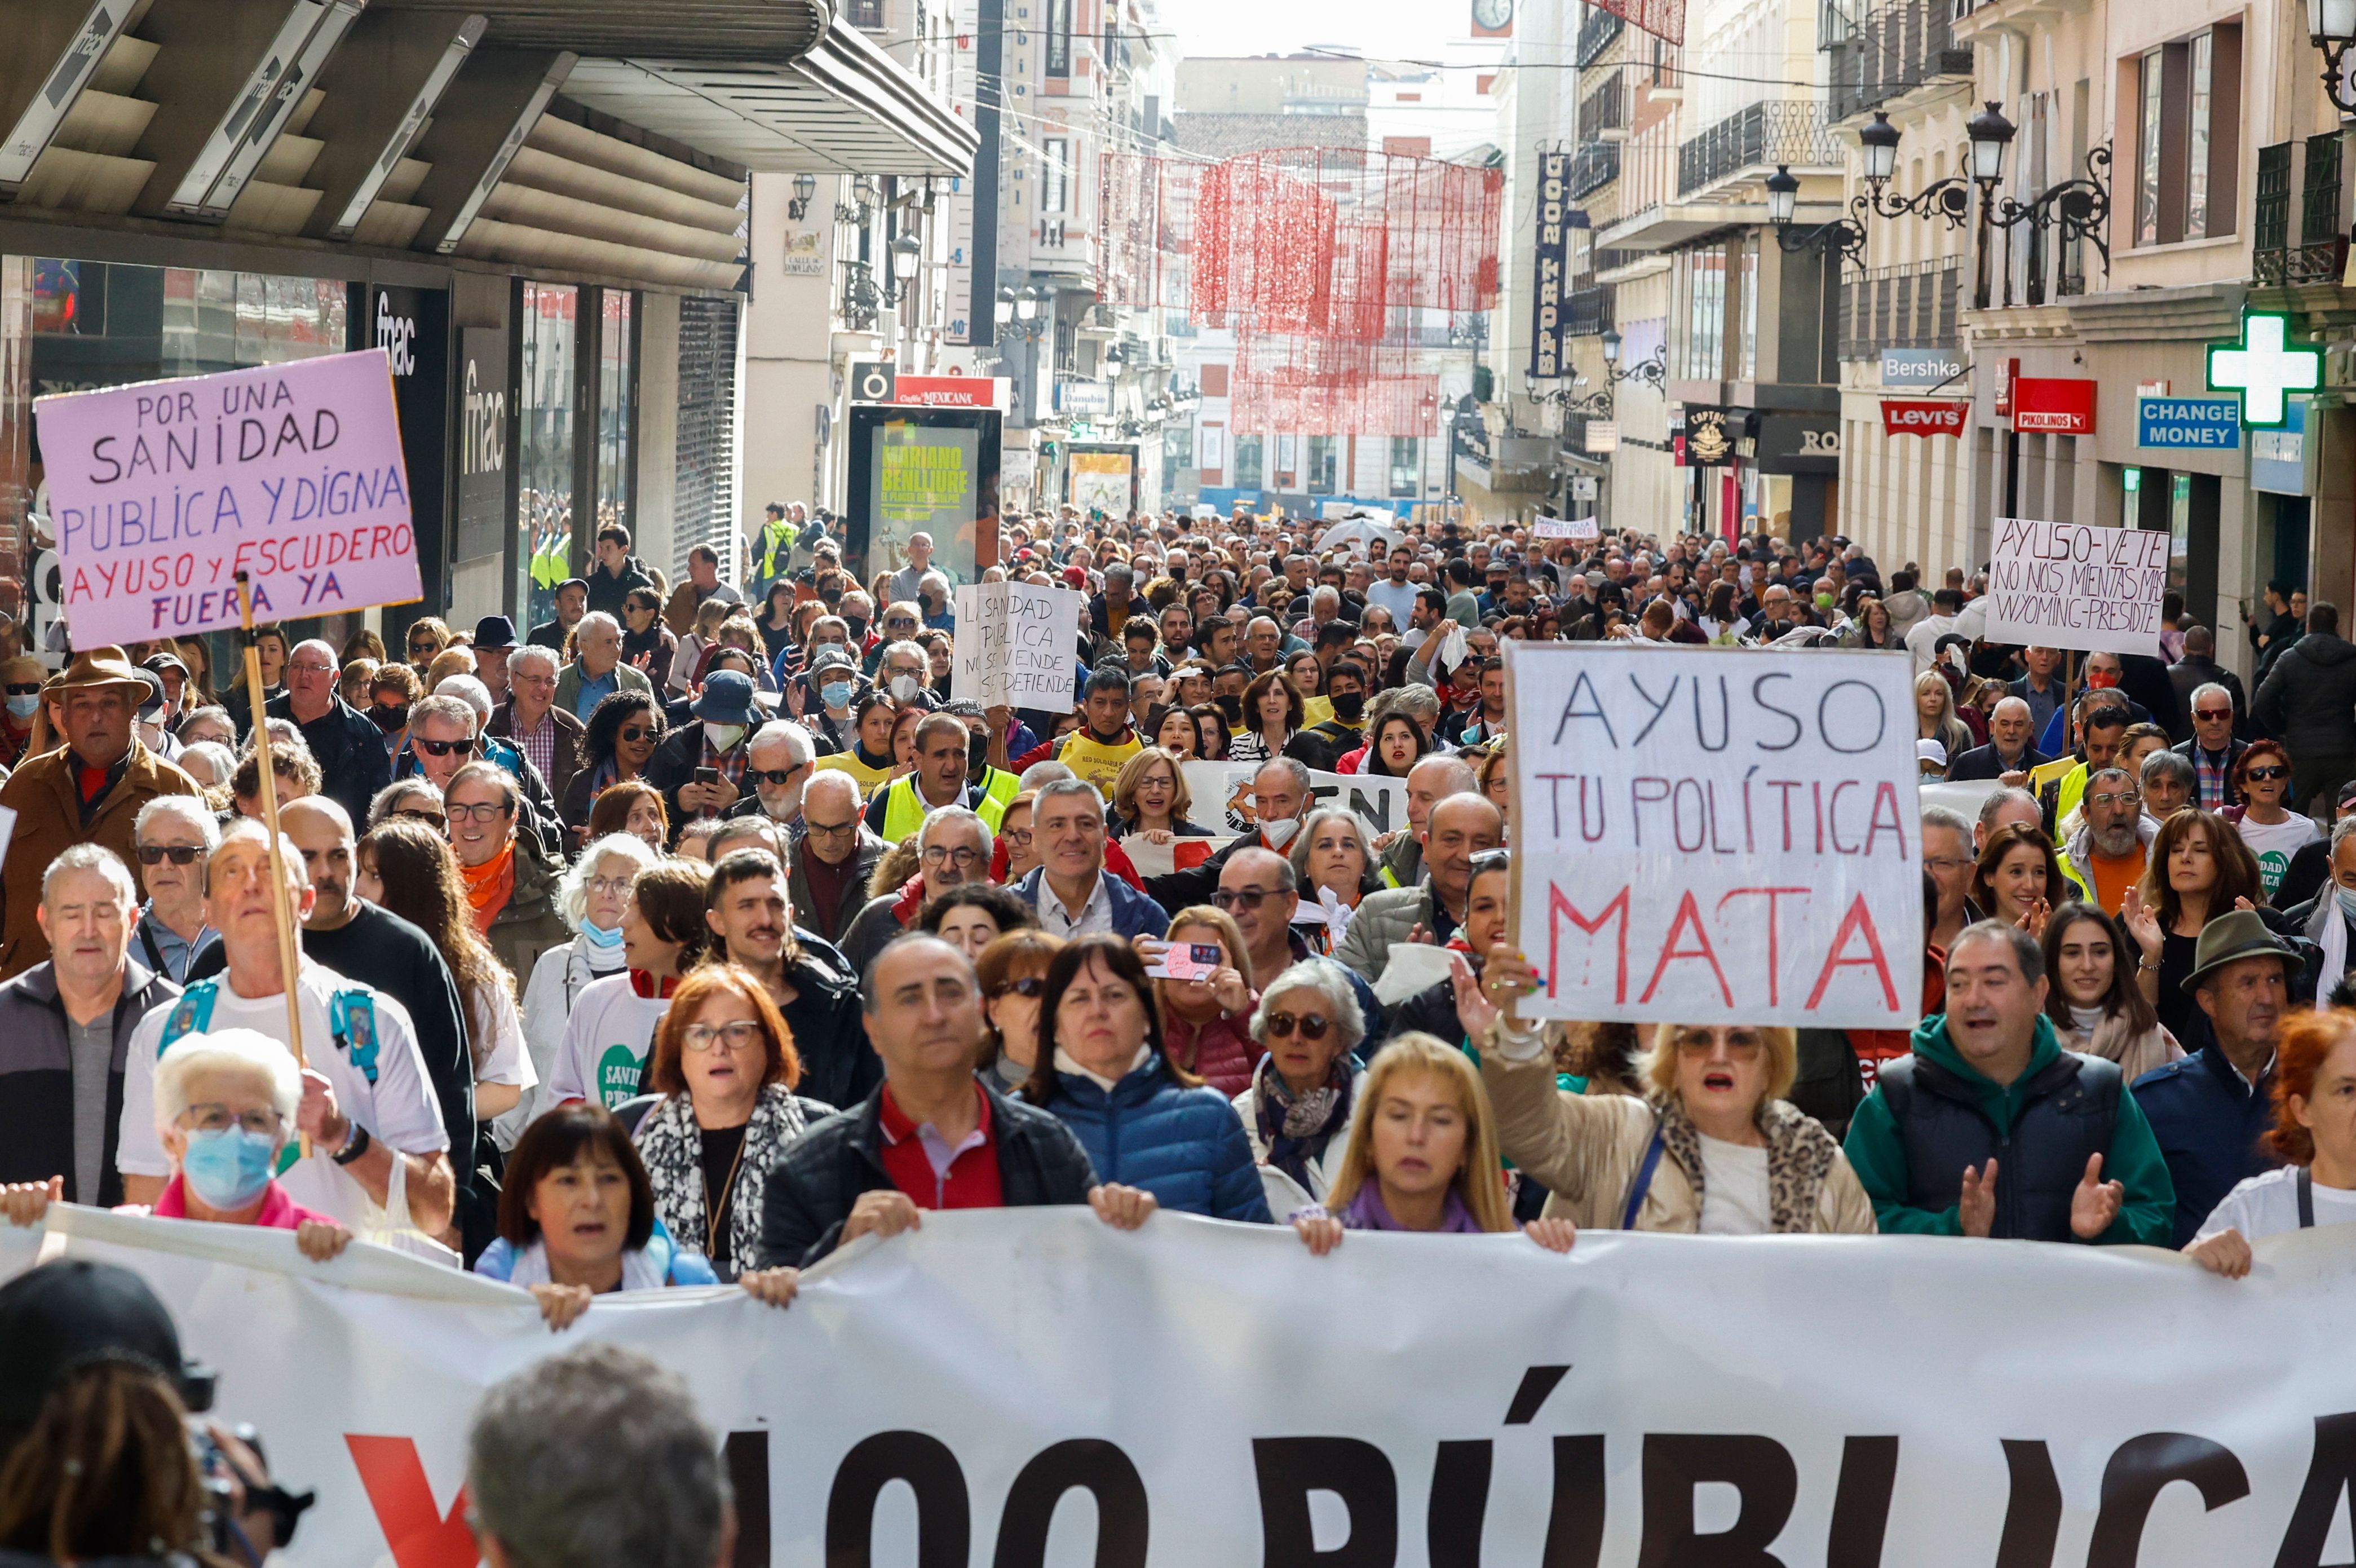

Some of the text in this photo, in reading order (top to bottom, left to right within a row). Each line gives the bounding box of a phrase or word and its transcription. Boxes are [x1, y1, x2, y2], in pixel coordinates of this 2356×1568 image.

[947, 320, 965, 337] -10
[1538, 258, 1558, 374] SPORT
[377, 291, 415, 376] fnac
[1886, 359, 1960, 377] Bershka
[136, 379, 294, 428] POR UNA
[1065, 394, 1106, 404] Danubio
[2143, 404, 2236, 421] CHANGE
[464, 359, 504, 475] fnac
[2022, 414, 2068, 426] PIKOLINOS
[2149, 427, 2230, 444] MONEY
[882, 445, 962, 470] MARIANO
[881, 468, 968, 493] BENLLIURE
[261, 477, 284, 524] Y
[1995, 520, 2170, 568] AYUSO-VETE
[69, 553, 193, 604] AYUSO
[232, 523, 413, 580] ESCUDERO
[1994, 560, 2019, 590] NO
[2026, 562, 2063, 593] NOS
[2138, 568, 2167, 602] MAS
[152, 570, 343, 629] FUERA YA
[981, 622, 1053, 648] PUBLICA
[1004, 650, 1064, 670] VENDE
[1001, 672, 1074, 693] DEFIENDE
[1553, 670, 1885, 753] AYUSO
[1094, 757, 1118, 767] SOLIDARIA
[1535, 765, 1907, 861] TU POLÍTICA
[1547, 880, 1902, 1012] MATA
